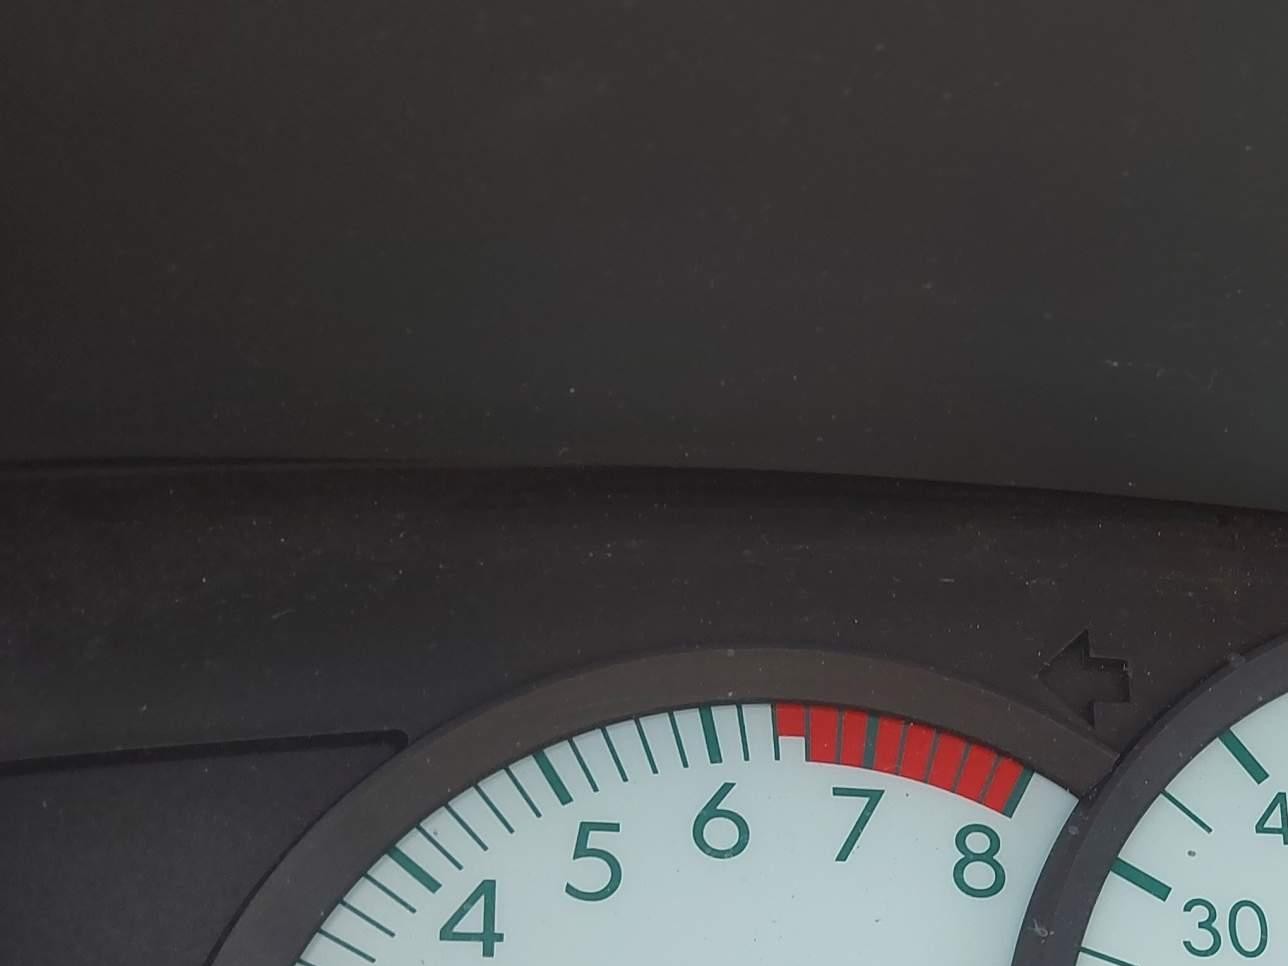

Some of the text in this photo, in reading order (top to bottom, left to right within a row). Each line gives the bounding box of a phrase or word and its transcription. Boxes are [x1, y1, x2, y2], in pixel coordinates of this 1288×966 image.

[693, 782, 749, 859] 6
[832, 787, 885, 861] 7
[565, 821, 622, 901] 5
[953, 824, 1005, 898] 8
[440, 880, 504, 957] 4
[1183, 898, 1268, 958] 30
